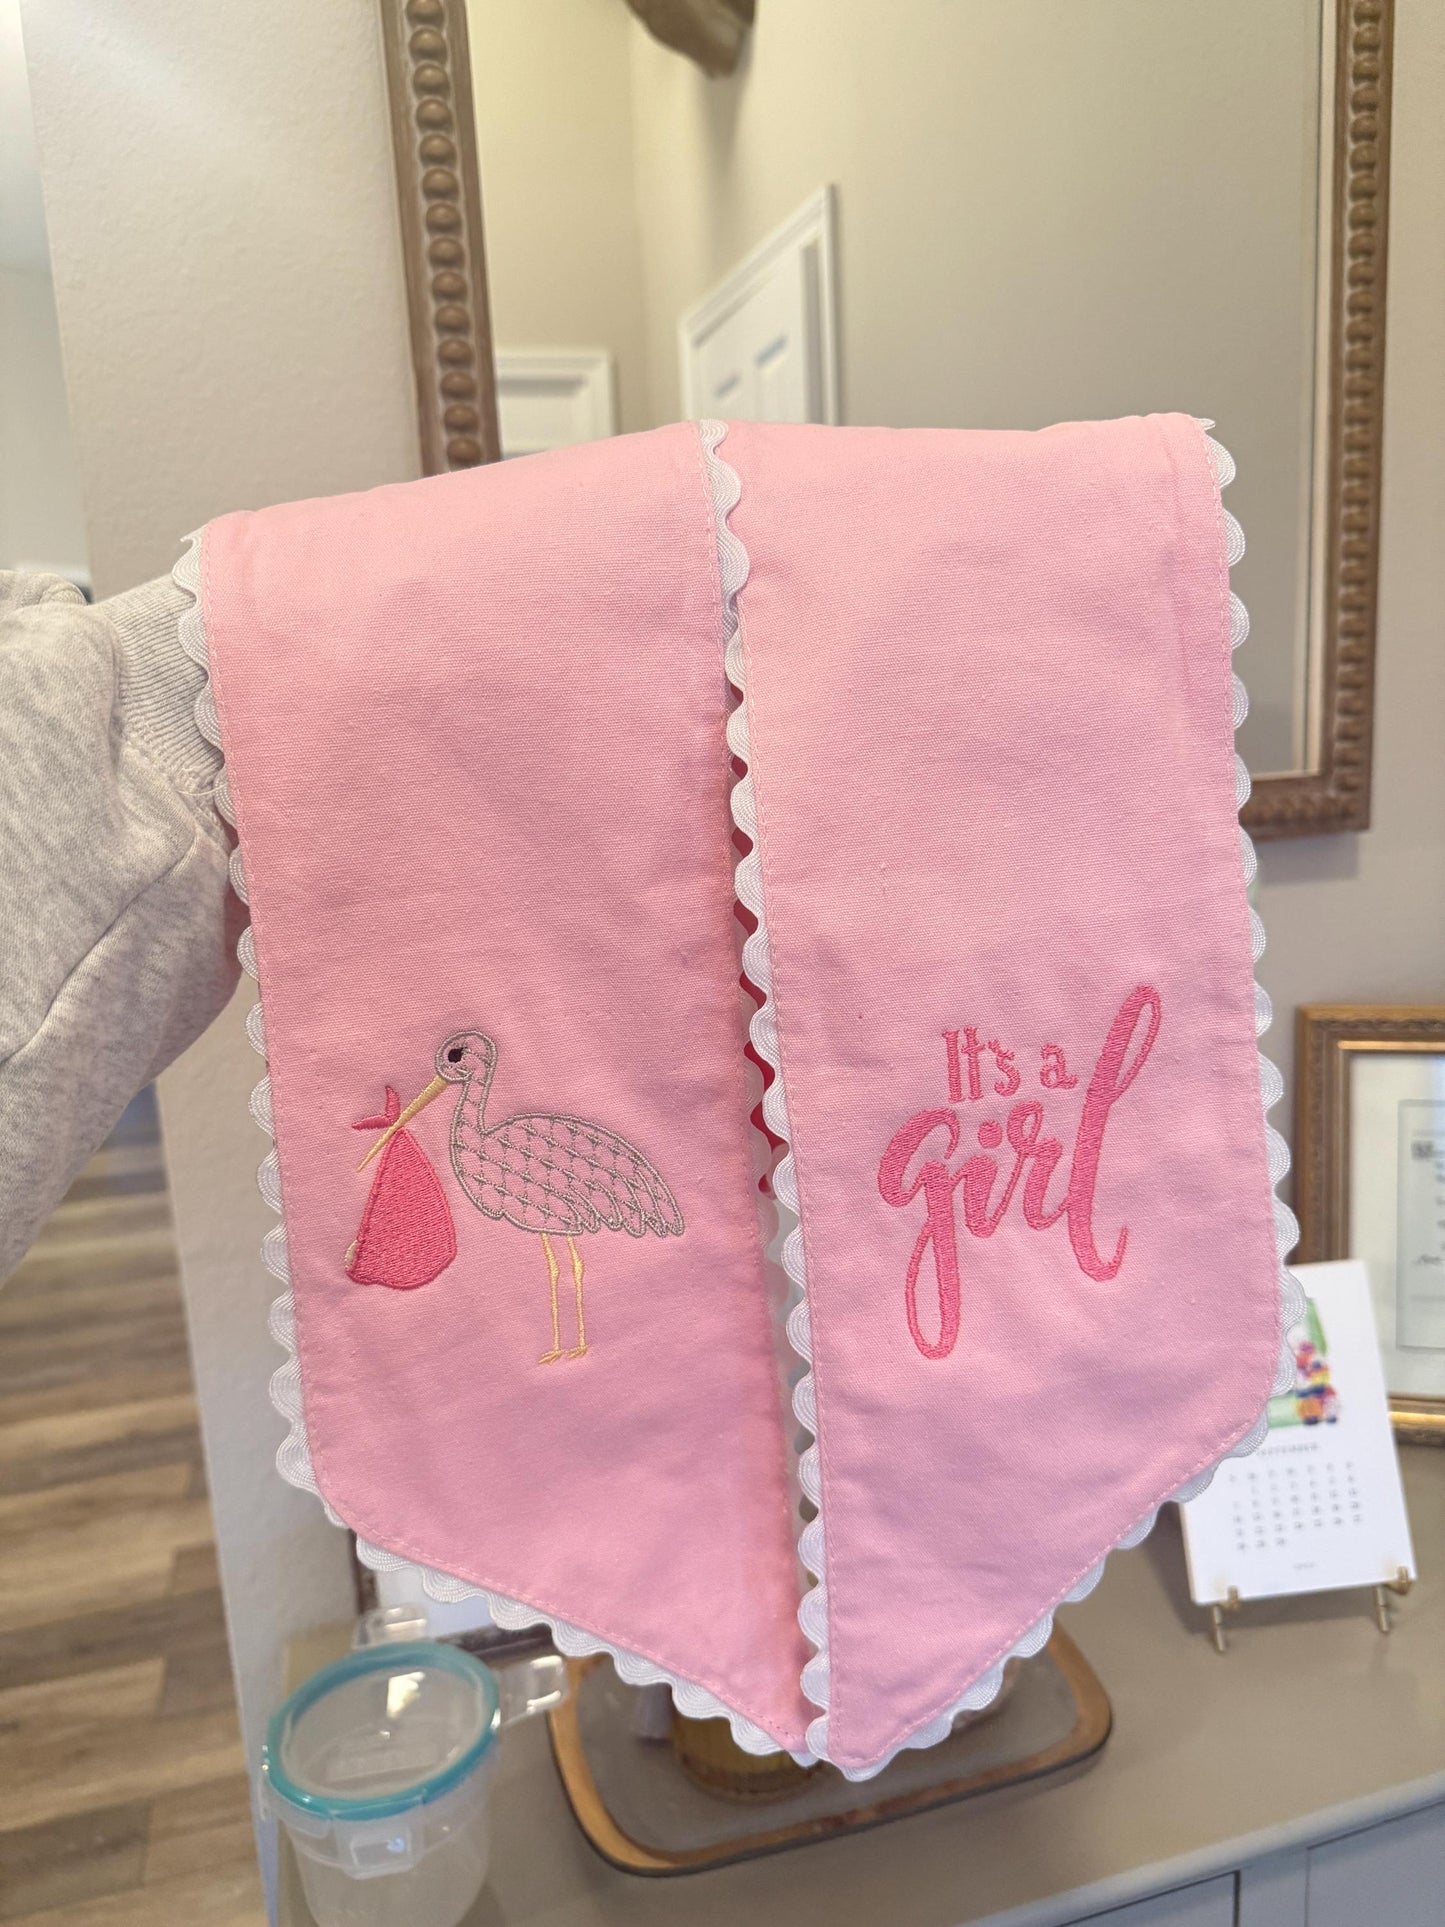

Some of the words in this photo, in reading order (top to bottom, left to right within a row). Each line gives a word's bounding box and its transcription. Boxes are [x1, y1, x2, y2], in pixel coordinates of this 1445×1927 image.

[877, 985, 1162, 1360] girl
[942, 1026, 1021, 1103] It's
[1039, 1043, 1078, 1089] a
